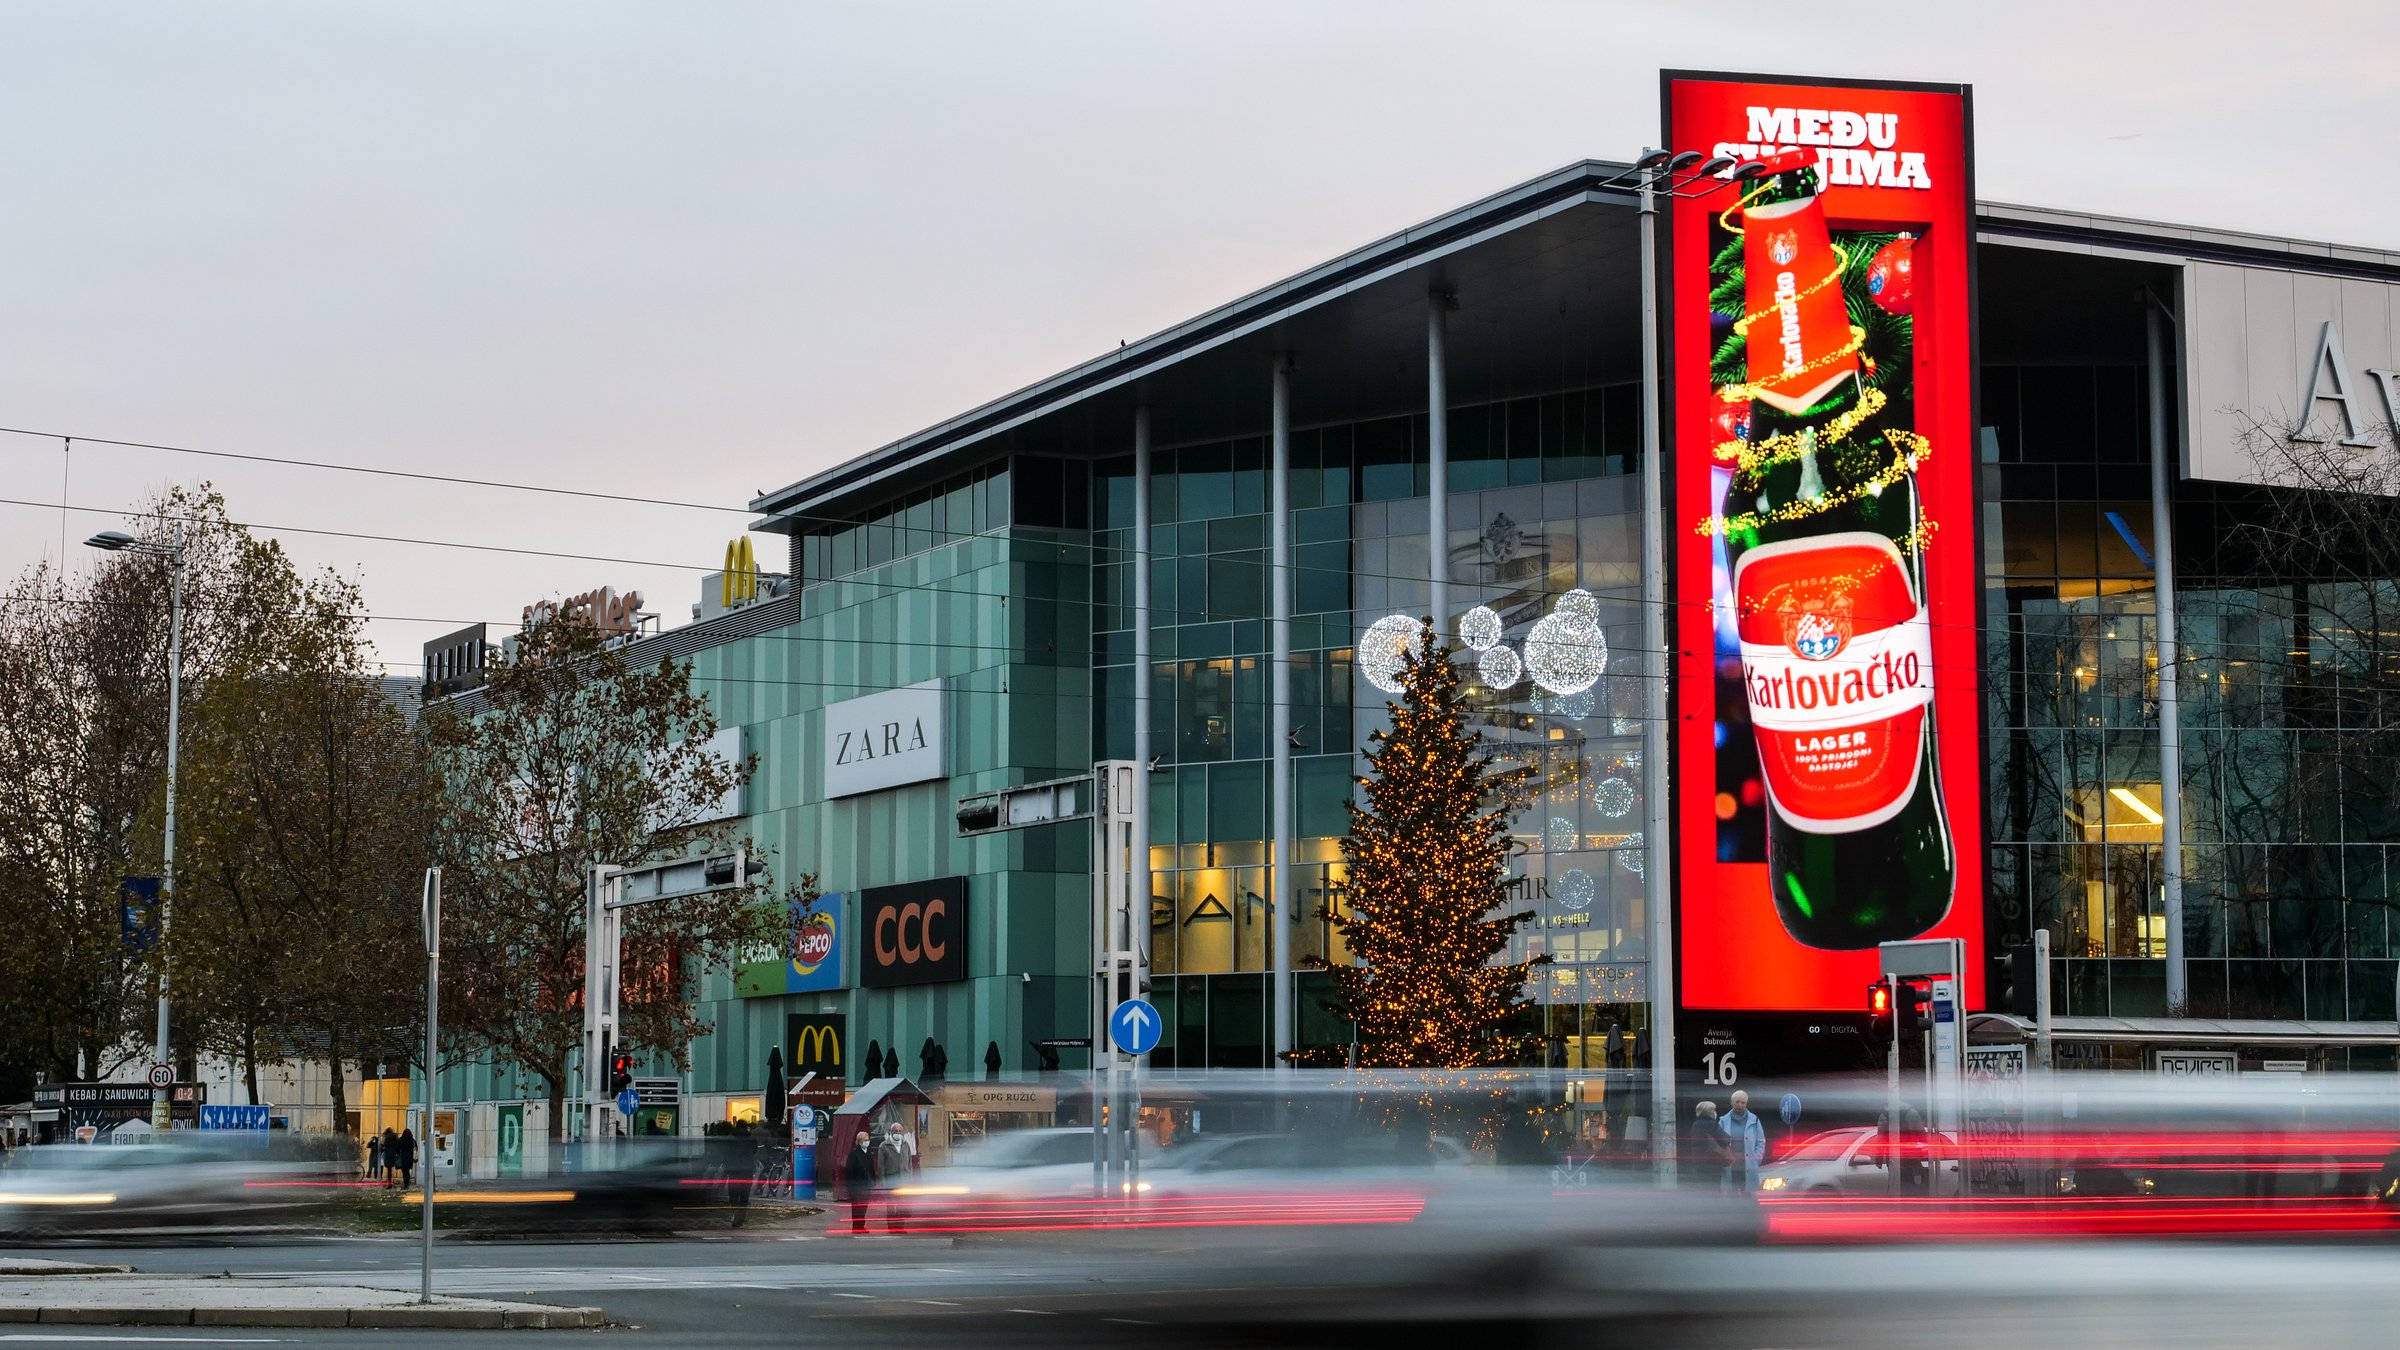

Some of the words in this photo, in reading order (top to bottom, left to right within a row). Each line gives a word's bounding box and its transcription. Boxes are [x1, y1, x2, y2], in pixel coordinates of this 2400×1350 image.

[1746, 106, 1898, 149] MEĐU
[1712, 142, 1932, 194] SJIMA
[1744, 649, 1919, 710] Karlovačko
[836, 716, 928, 766] ZARA
[1795, 731, 1867, 752] LAGER
[1795, 754, 1819, 764] 100%
[1821, 747, 1872, 763] PRIRODNI
[1808, 759, 1859, 773] SASTOJCI
[874, 898, 946, 967] CCC
[799, 933, 829, 955] PEPCO
[1707, 1028, 1733, 1038] Avenija
[1831, 1025, 1859, 1034] DIGITAL
[1703, 1037, 1737, 1046] Dubrovnik
[154, 1070, 169, 1083] 60
[1702, 1051, 1738, 1086] 16
[70, 1089, 97, 1101] KEBAB
[104, 1088, 149, 1100] SANDWICH
[983, 1093, 1003, 1102] OPG
[1006, 1090, 1037, 1102] RUŽIĆ
